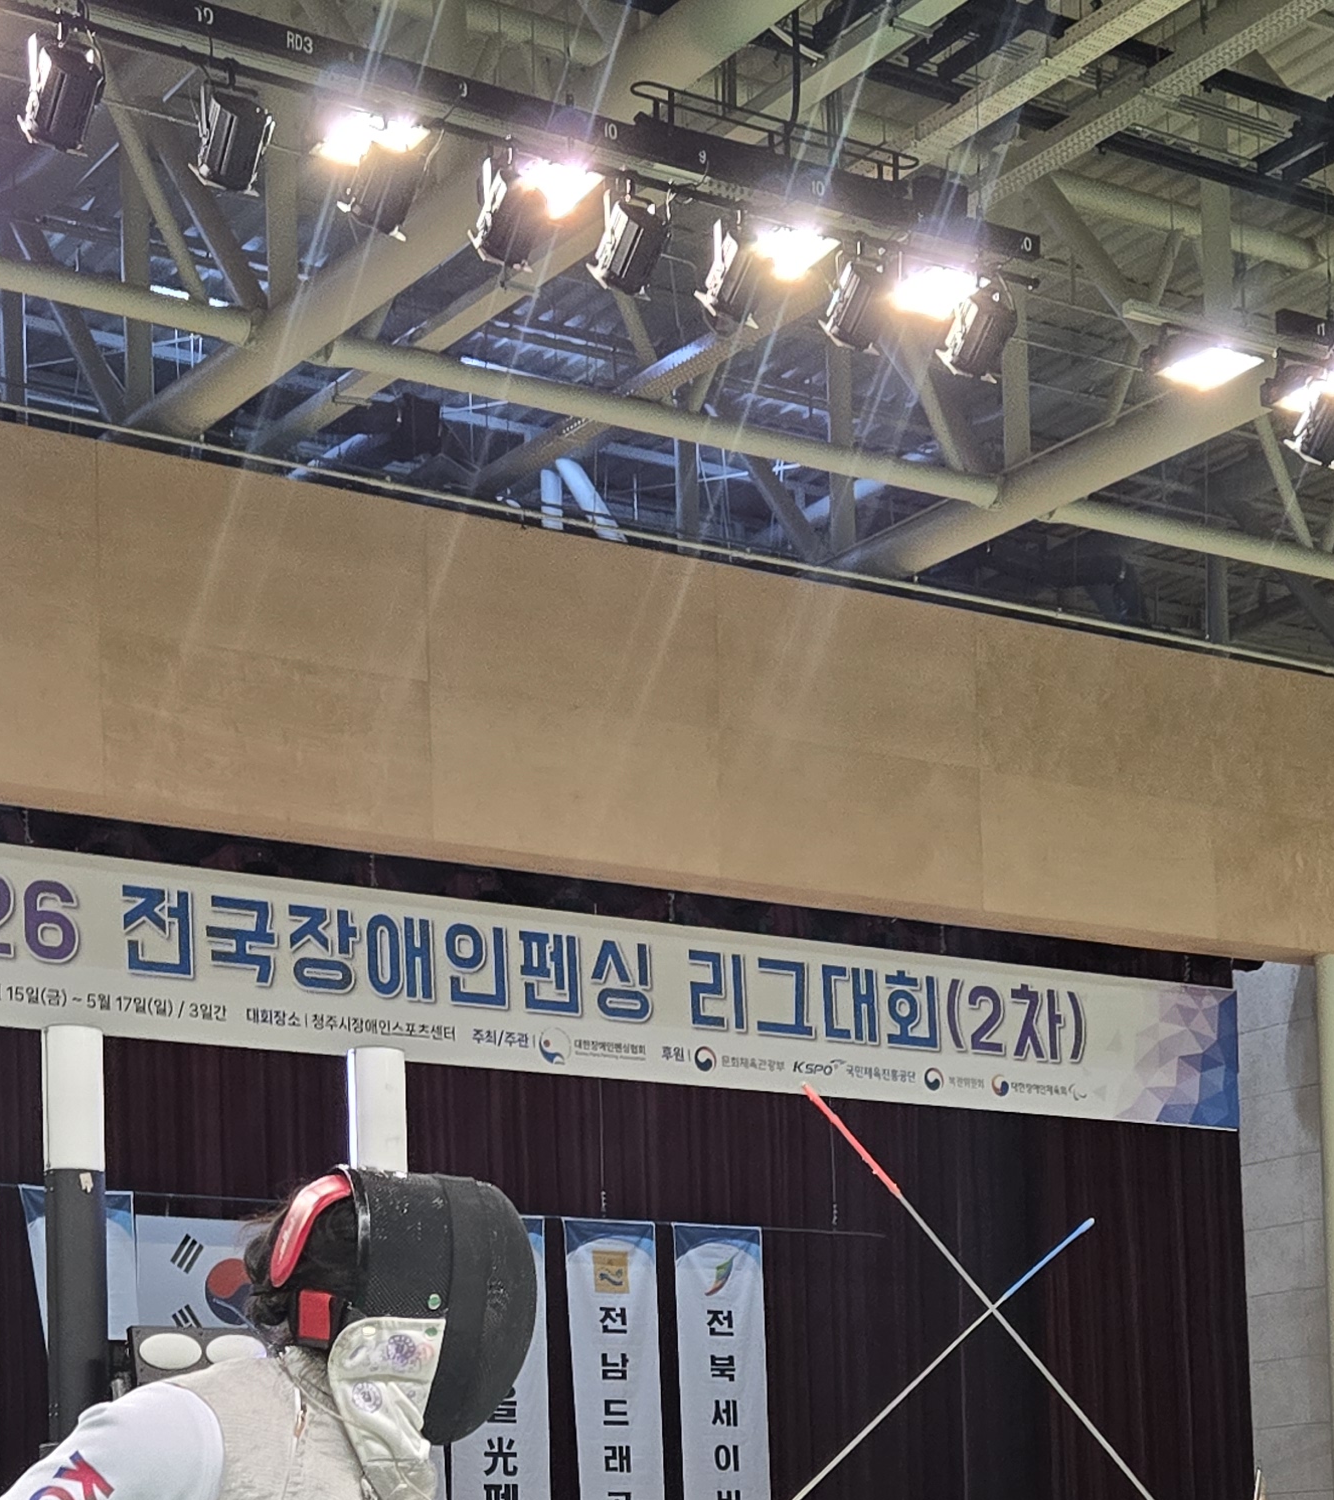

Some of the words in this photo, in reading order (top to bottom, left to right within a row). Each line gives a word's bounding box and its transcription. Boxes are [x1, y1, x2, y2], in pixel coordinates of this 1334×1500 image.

[286, 30, 313, 53] RD3
[604, 122, 617, 140] 10
[698, 150, 707, 164] 9
[812, 180, 824, 196] 10
[121, 882, 653, 1022] 전국장애인펜싱
[688, 949, 1086, 1064] 리그대회(2차)
[7, 986, 67, 1008] 15일(금)
[87, 993, 111, 1011] 5월
[116, 996, 174, 1018] 17일(일)
[189, 1002, 227, 1022] 3일간
[246, 1007, 300, 1028] 대회장소
[312, 1013, 456, 1042] 청주시장애인스포츠센터
[472, 1028, 529, 1049] 주최/주관
[574, 1038, 647, 1057] 대한장애인펜싱협회
[721, 1054, 785, 1072] 문화체육관광부
[793, 1060, 834, 1076] KSPO
[845, 1064, 916, 1084] 국민체육진흥공단
